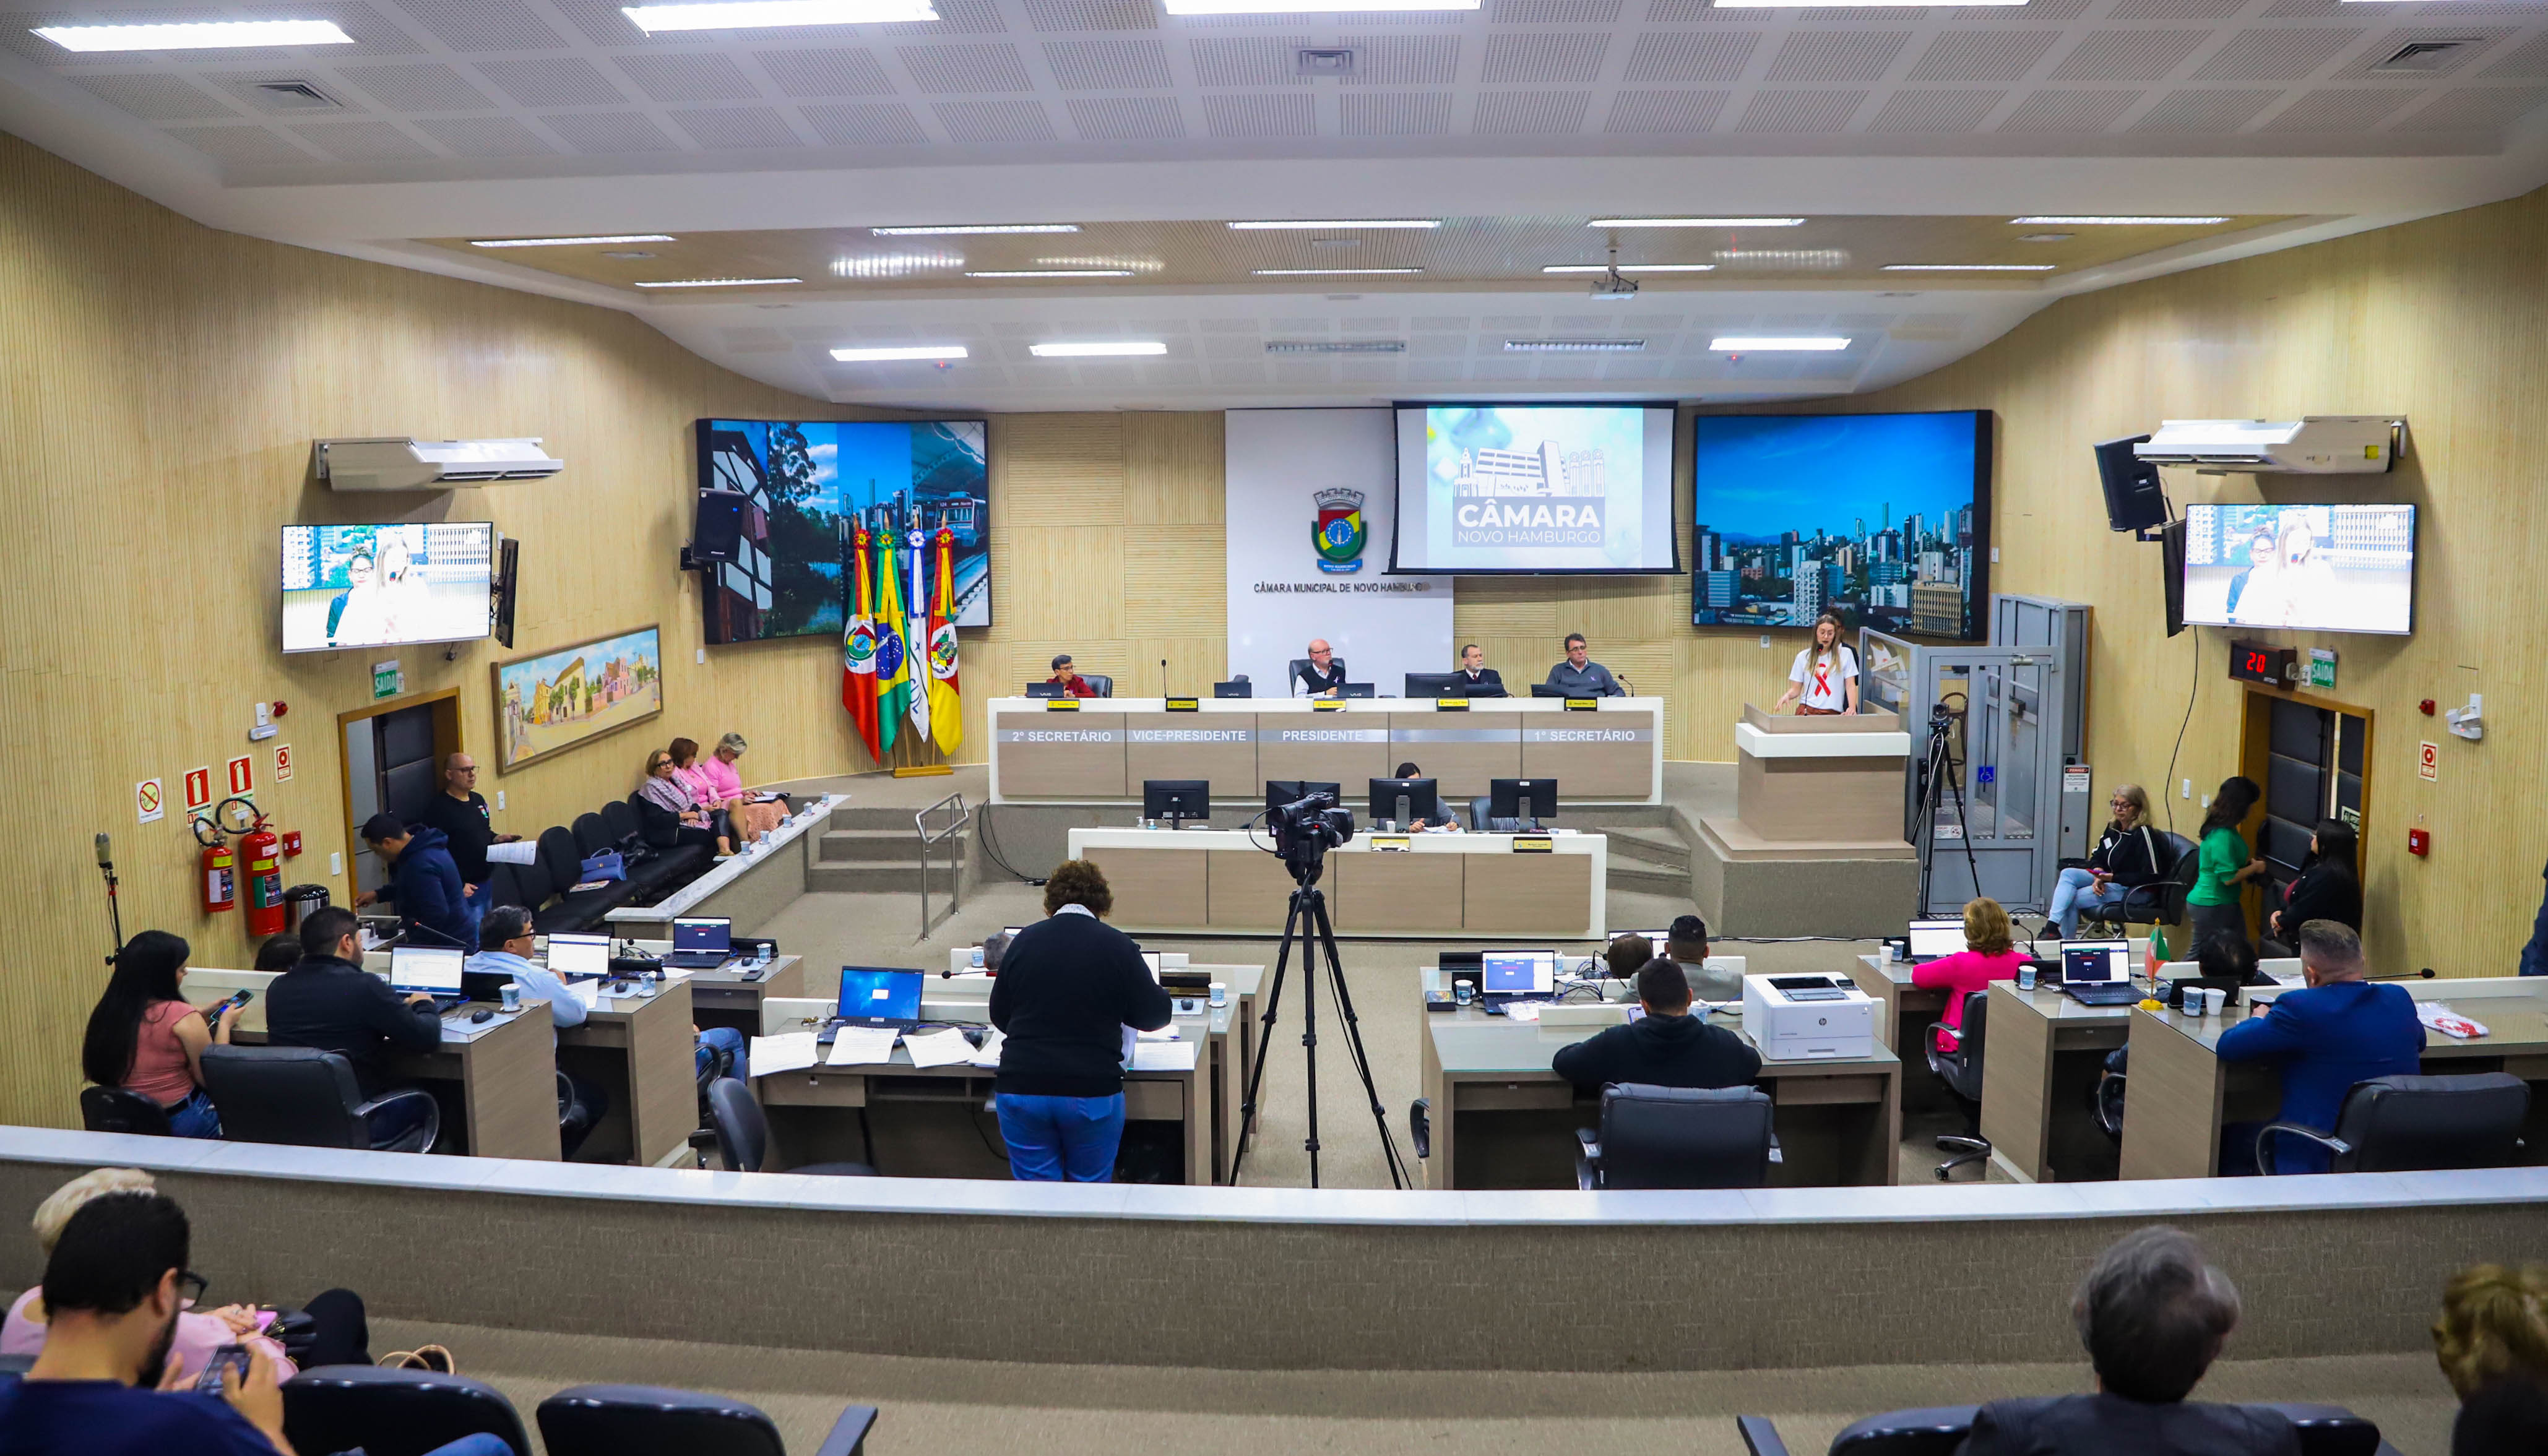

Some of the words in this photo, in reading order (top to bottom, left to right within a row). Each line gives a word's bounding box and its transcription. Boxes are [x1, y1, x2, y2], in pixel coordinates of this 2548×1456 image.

[1458, 499, 1600, 528] CÂMARA
[1458, 531, 1504, 543] NOVO
[1508, 531, 1601, 543] HAMBURGO
[1254, 581, 1292, 593] CÂMARA
[1293, 582, 1337, 593] MUNICIPAL
[1339, 583, 1351, 592] DE
[1354, 582, 1379, 592] NOVO
[2247, 652, 2266, 673] 20
[2312, 661, 2333, 682] SAÍDA
[376, 673, 396, 692] SAÍDA
[1028, 729, 1112, 741] SECRETÁRIO
[1133, 730, 1247, 741] VICE-PRESIDENTE
[1283, 731, 1363, 741] PRESIDENTE
[1550, 728, 1635, 741] SECRETÁRIO
